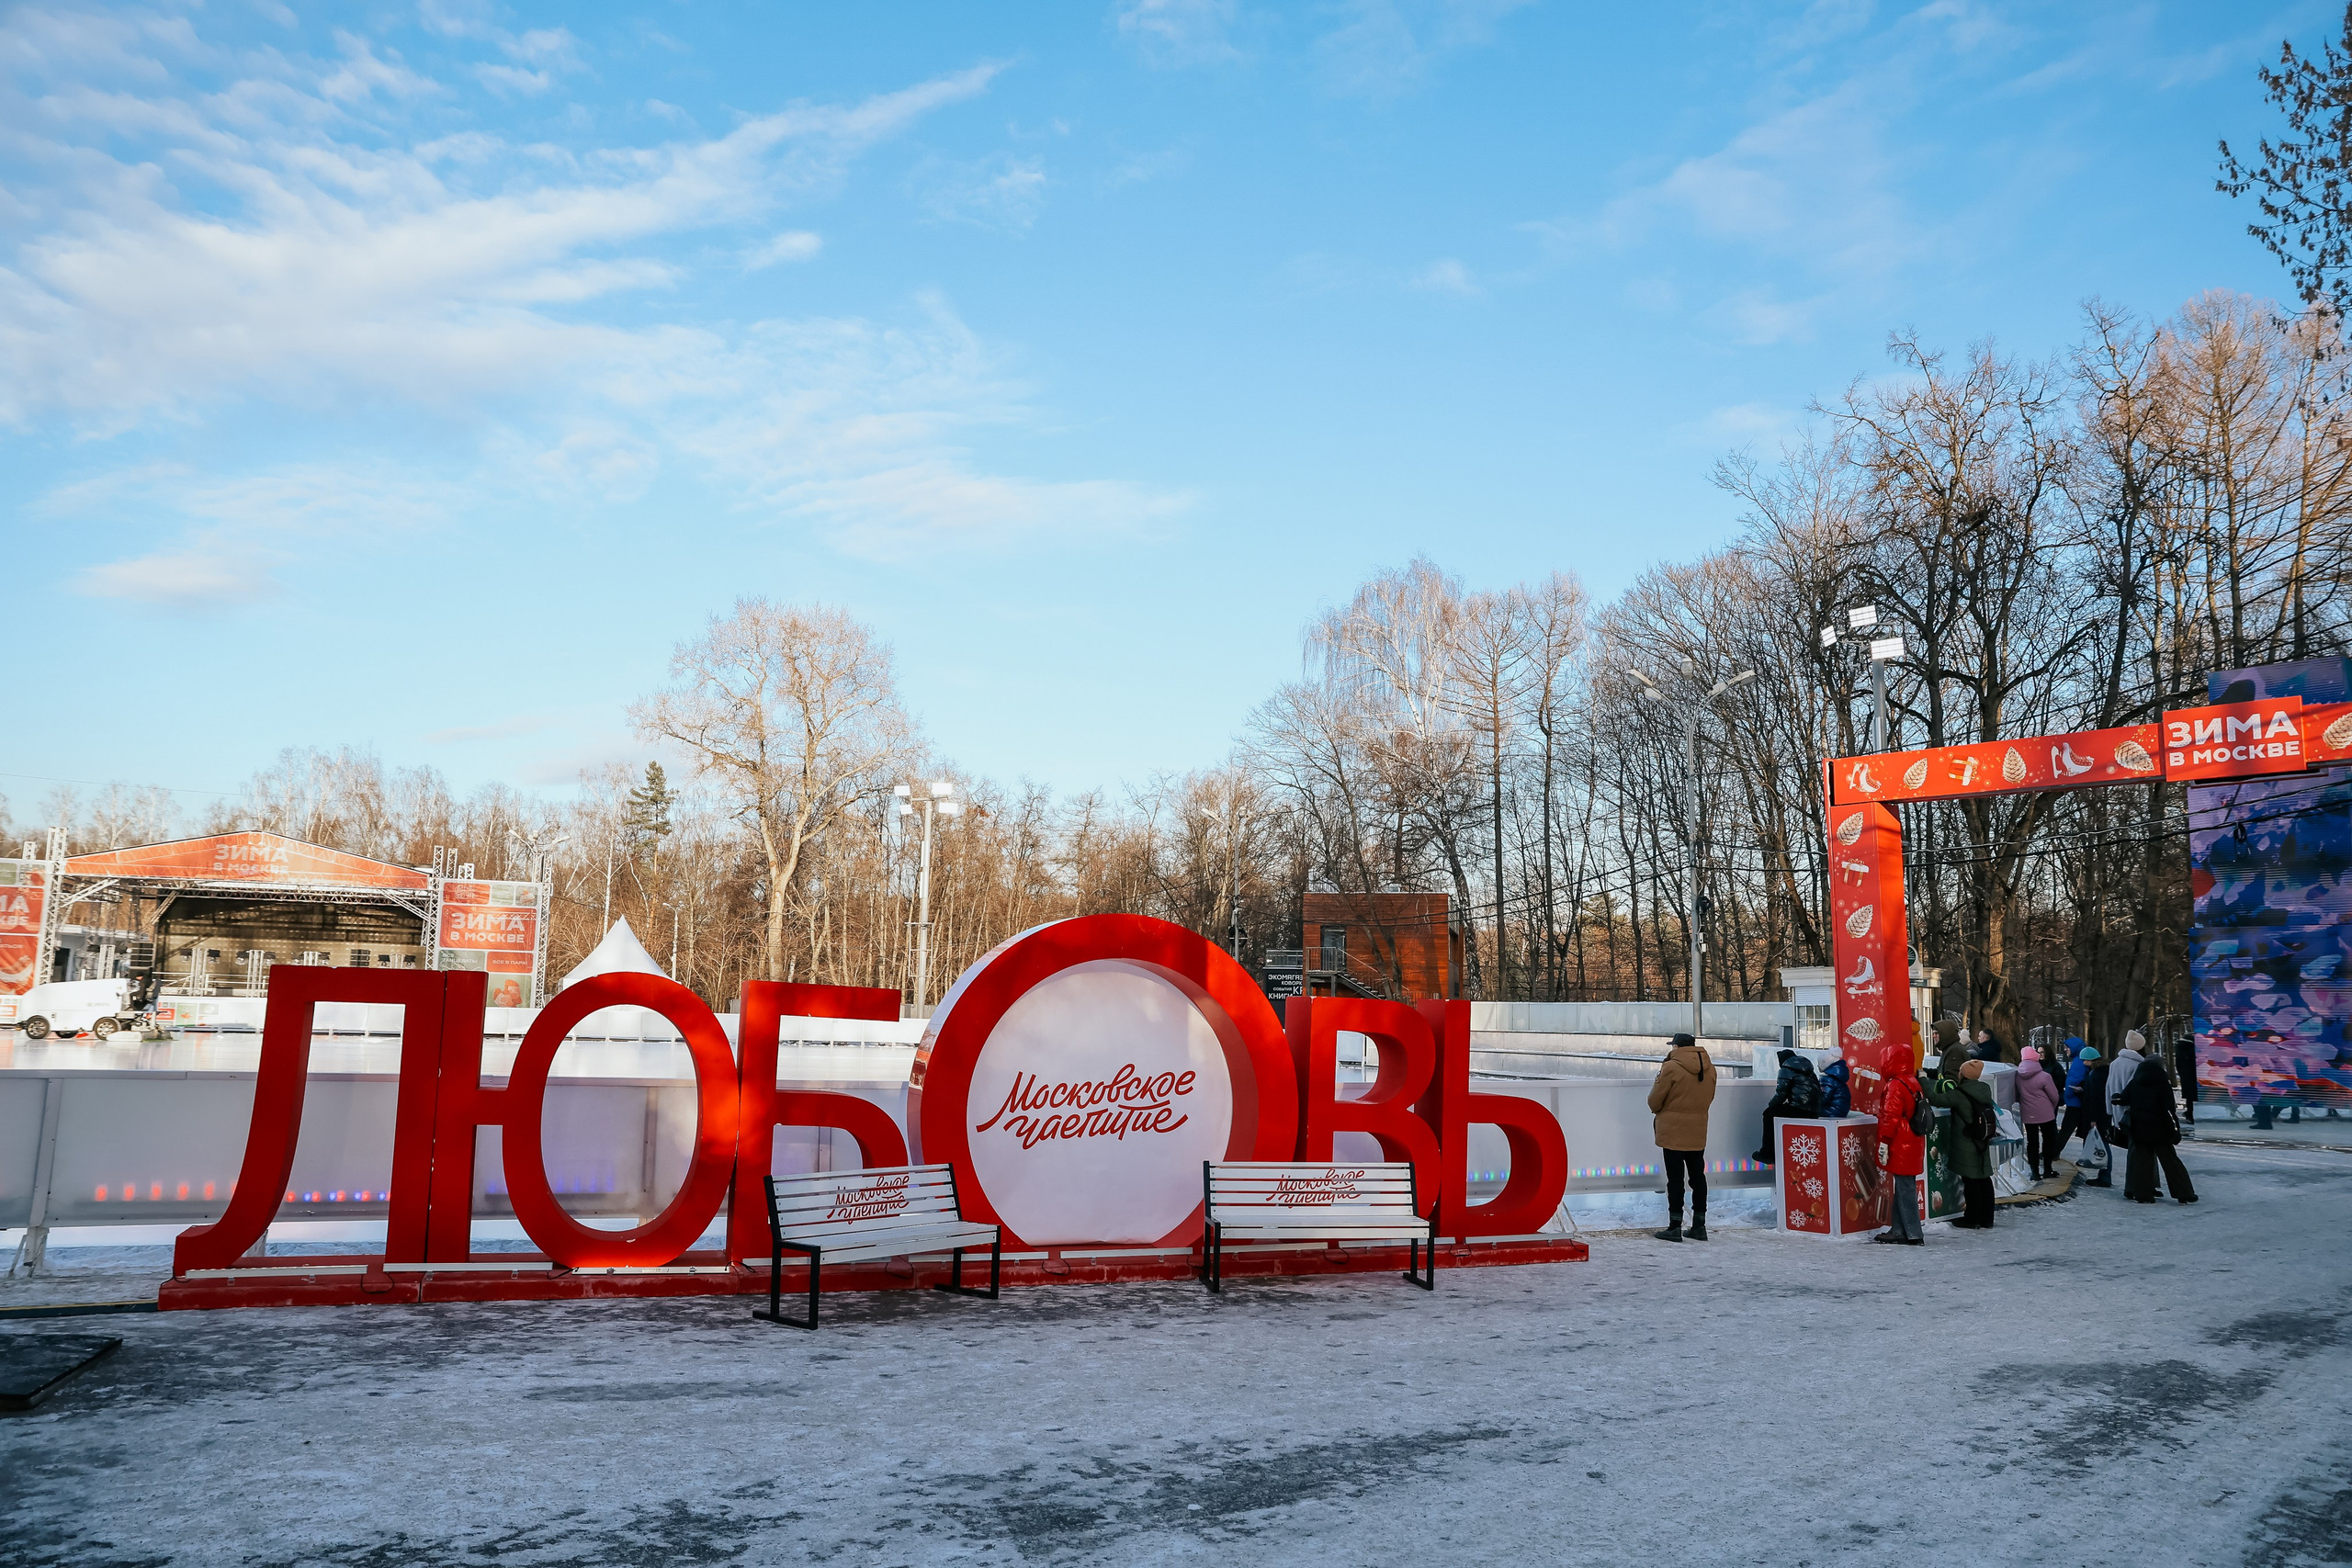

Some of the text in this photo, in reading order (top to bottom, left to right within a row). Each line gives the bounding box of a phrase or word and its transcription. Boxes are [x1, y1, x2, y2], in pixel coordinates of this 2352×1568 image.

[2168, 711, 2300, 748] ЗИМА
[2169, 740, 2301, 766] В МОСКВЕ
[215, 844, 288, 863] ЗИМА
[213, 863, 288, 874] В МОСКВЕ
[451, 912, 526, 931] ЗИМА
[450, 931, 525, 943] В МОСКВЕ
[175, 914, 1567, 1271] ЛЮБОВЬ
[976, 1064, 1195, 1133] Московское
[1003, 1100, 1189, 1150] чаепитие
